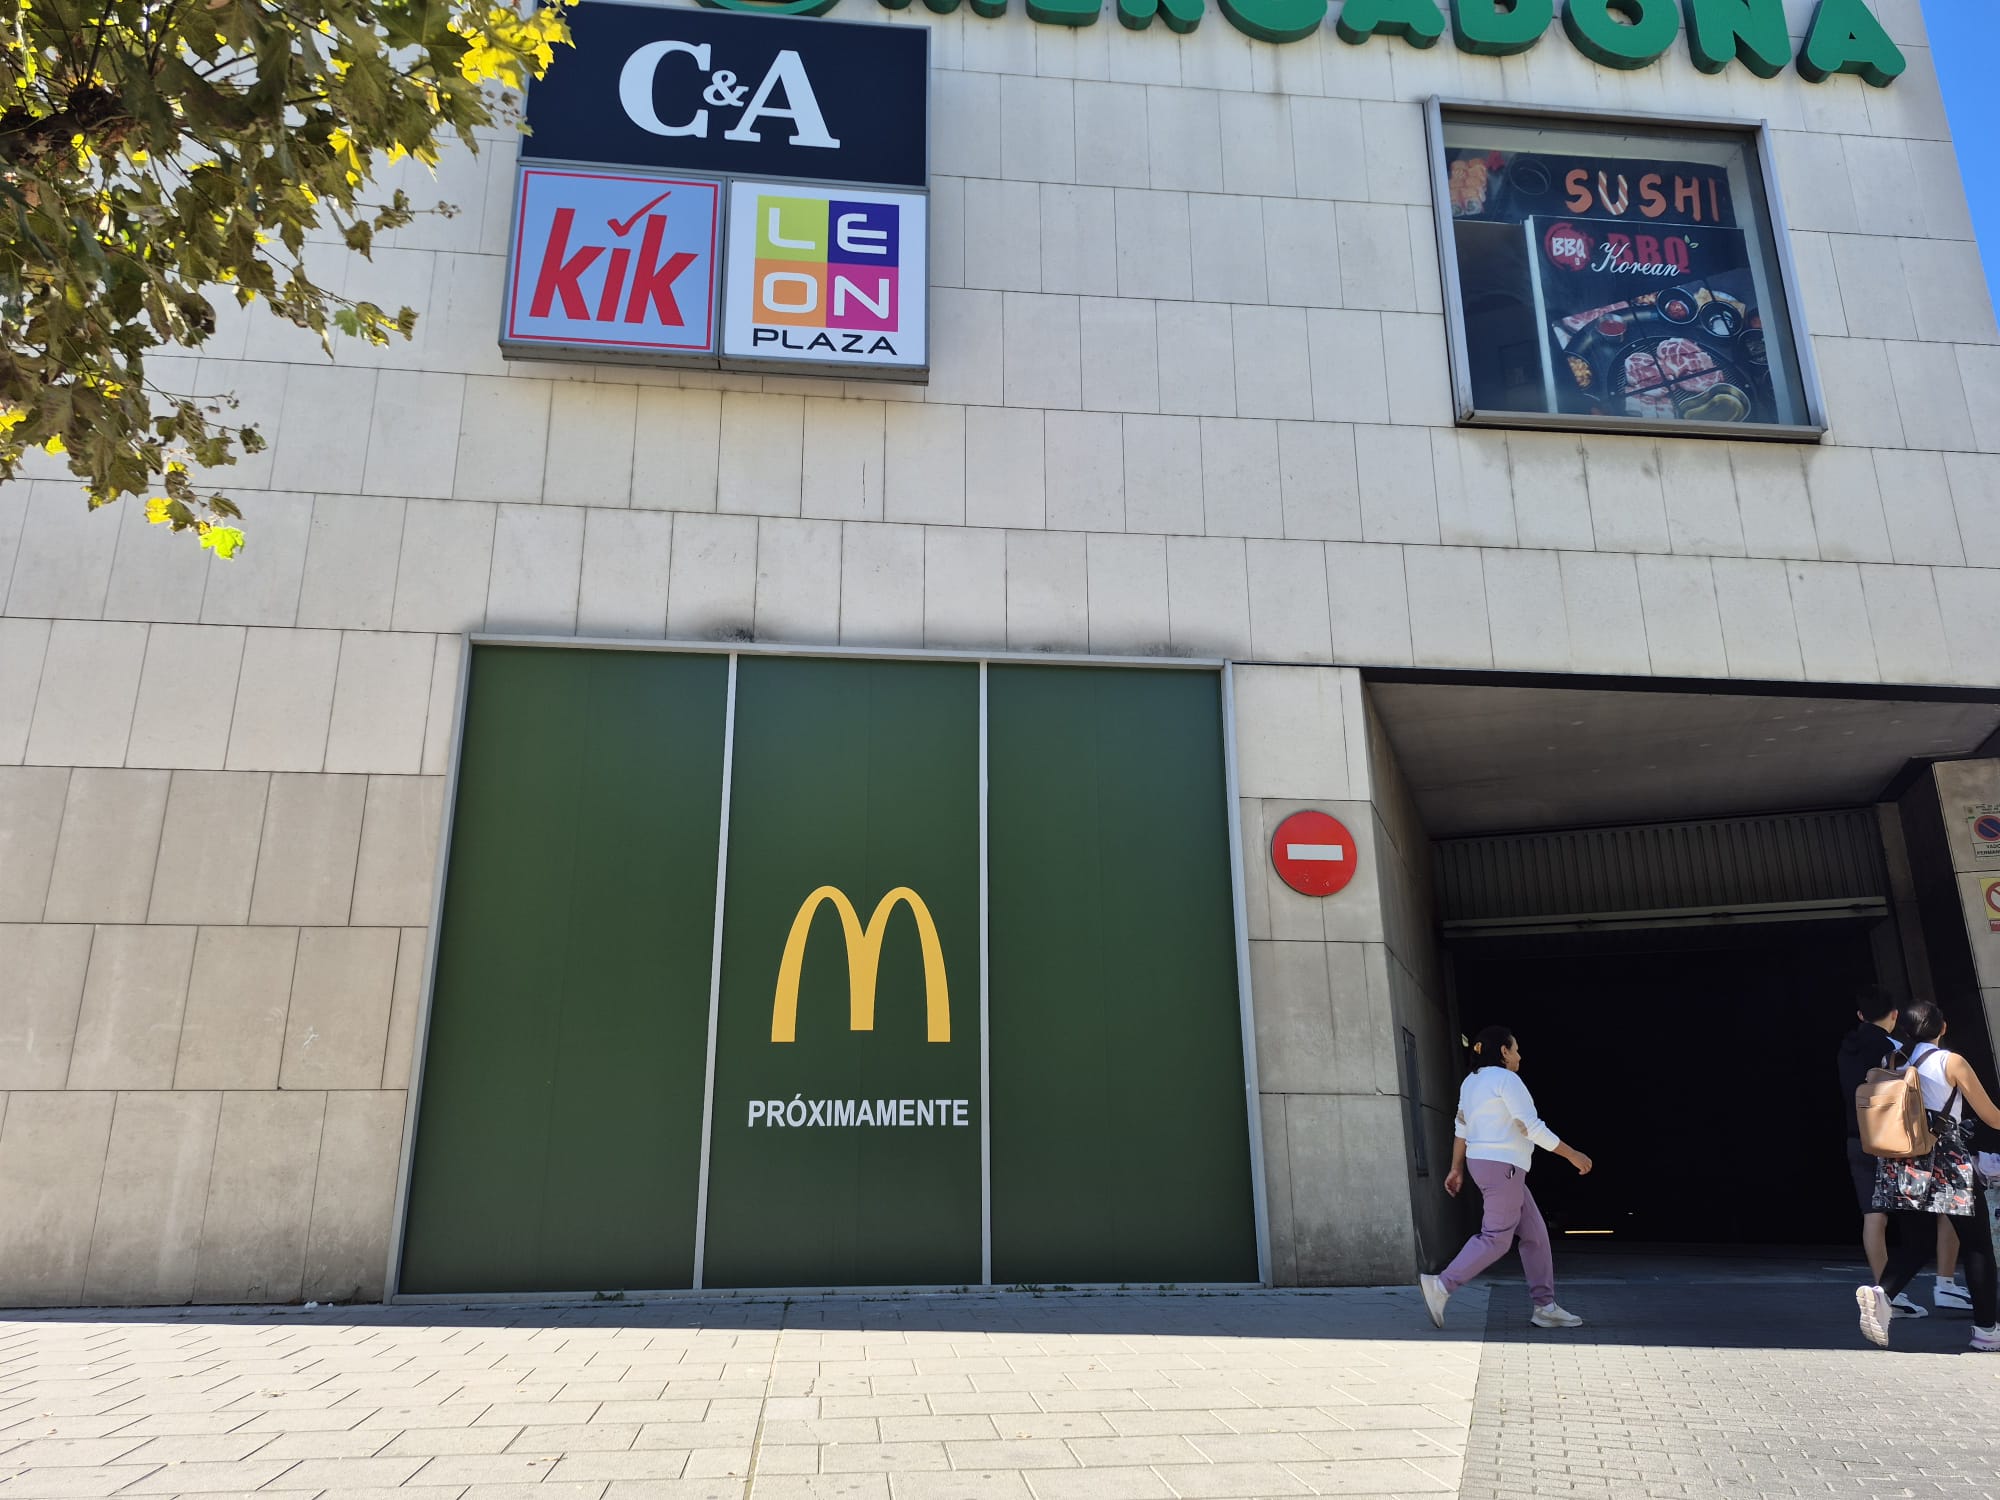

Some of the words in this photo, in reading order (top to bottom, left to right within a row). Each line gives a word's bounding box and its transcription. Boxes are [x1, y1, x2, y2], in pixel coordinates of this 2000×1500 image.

[618, 39, 841, 149] C&A
[1564, 168, 1720, 222] SUSHI
[1551, 236, 1587, 259] BBQ
[1591, 241, 1681, 277] Korean
[1607, 232, 1691, 274] BBQ
[752, 327, 898, 356] PLAZA
[747, 1093, 969, 1127] PRÓXIMAMENTE
